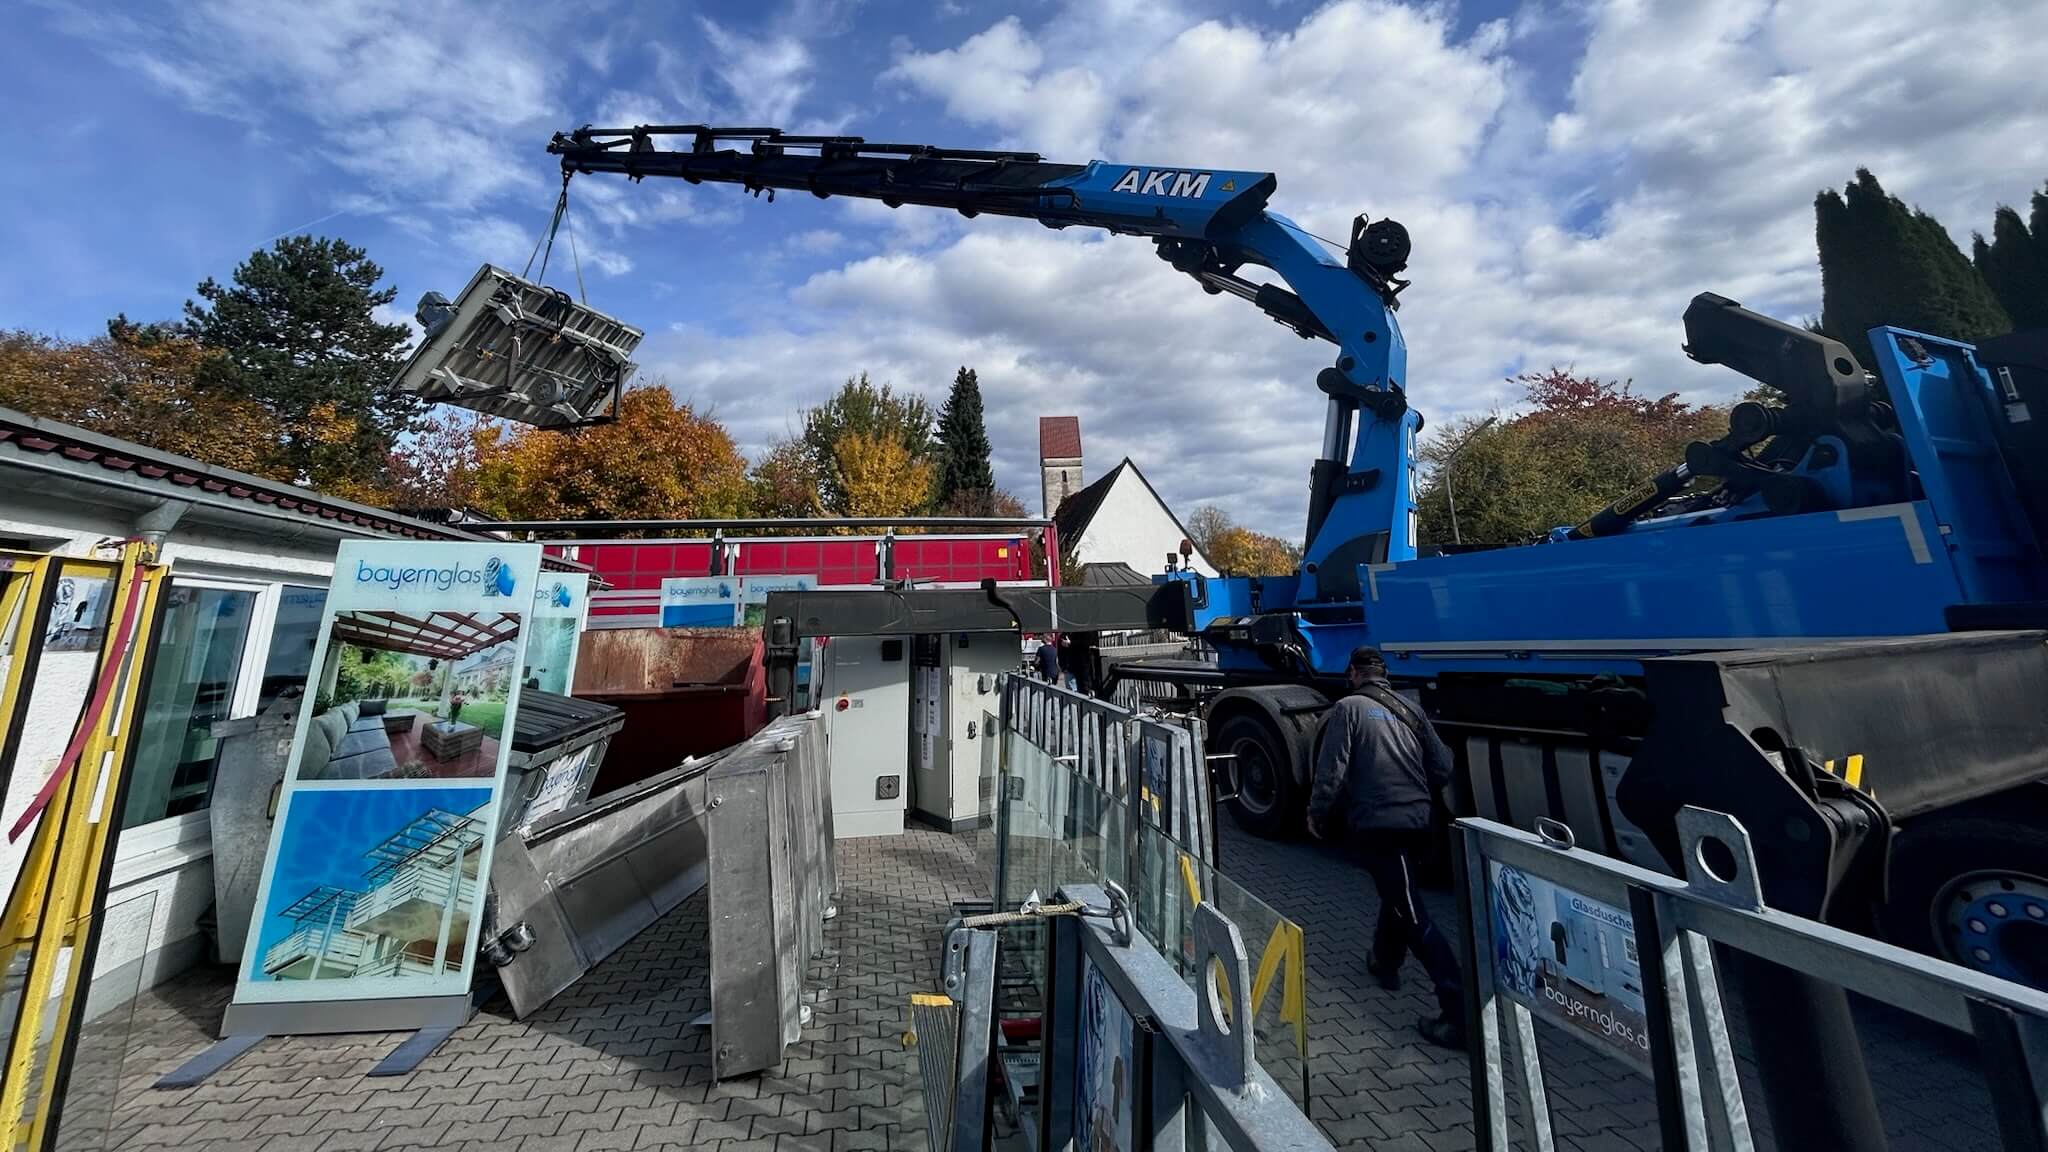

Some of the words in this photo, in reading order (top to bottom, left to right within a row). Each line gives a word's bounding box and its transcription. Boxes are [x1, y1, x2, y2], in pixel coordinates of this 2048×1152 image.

[1112, 168, 1211, 199] AKM
[356, 559, 481, 590] bayernglas
[670, 585, 717, 598] bayernglas
[1572, 897, 1632, 930] Glasdusche
[1543, 978, 1649, 1050] bayernglas.d
